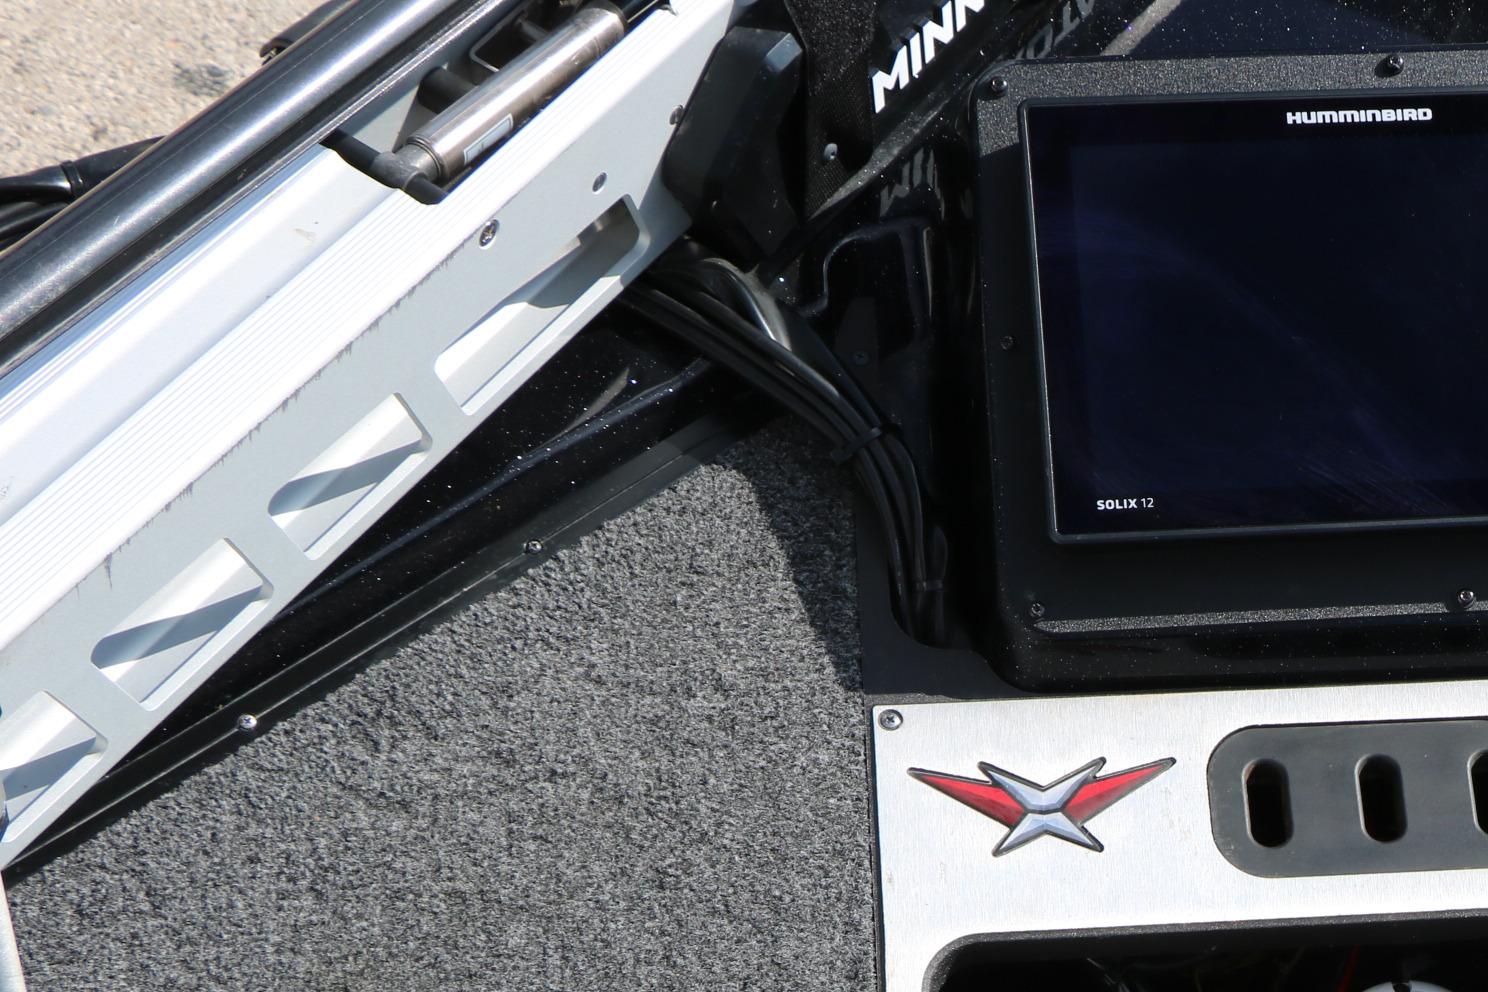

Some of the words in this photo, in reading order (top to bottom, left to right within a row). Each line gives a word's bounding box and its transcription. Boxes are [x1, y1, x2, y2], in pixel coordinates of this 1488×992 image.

[1286, 108, 1433, 124] HUMMINBIRD
[1096, 498, 1138, 511] SOLIX
[1140, 497, 1155, 508] 12
